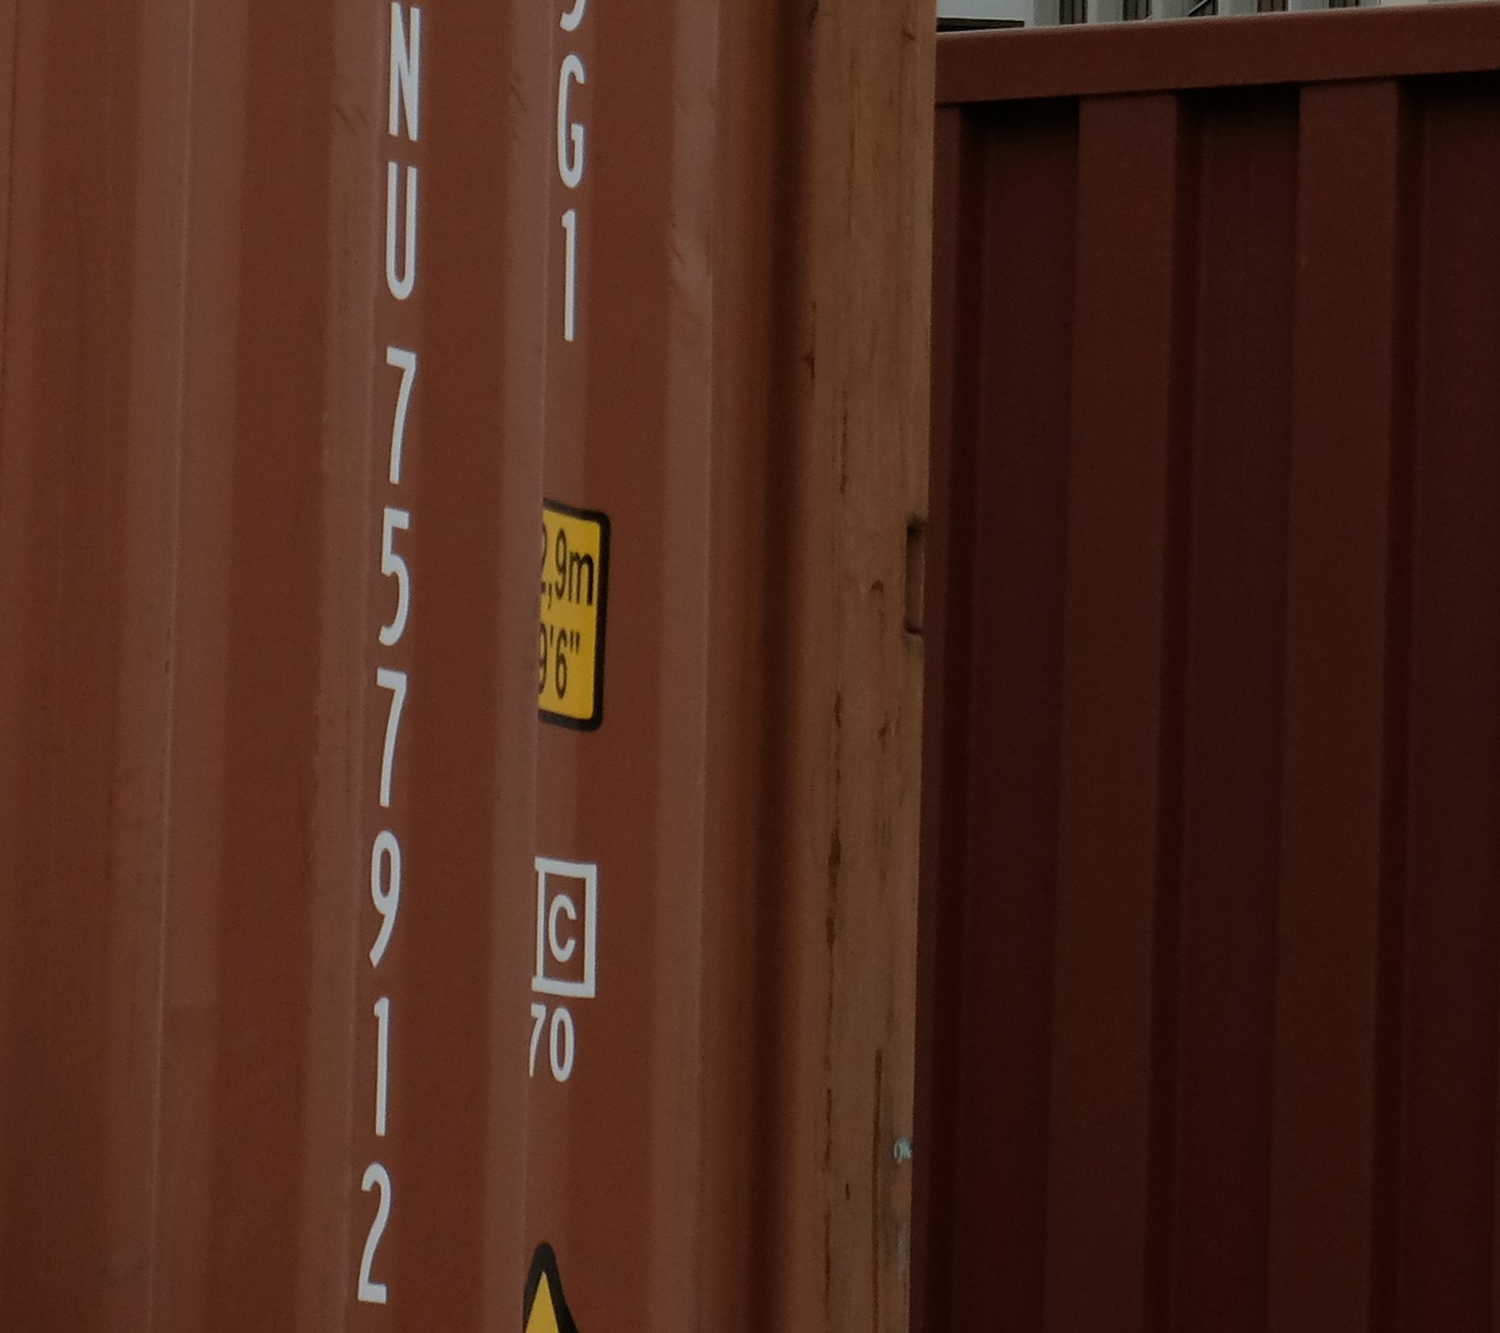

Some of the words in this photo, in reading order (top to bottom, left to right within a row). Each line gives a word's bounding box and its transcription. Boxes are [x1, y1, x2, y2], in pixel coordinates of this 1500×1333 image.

[357, 346, 417, 1304] 757912
[548, 894, 577, 963] C
[528, 1002, 575, 1083] 70
